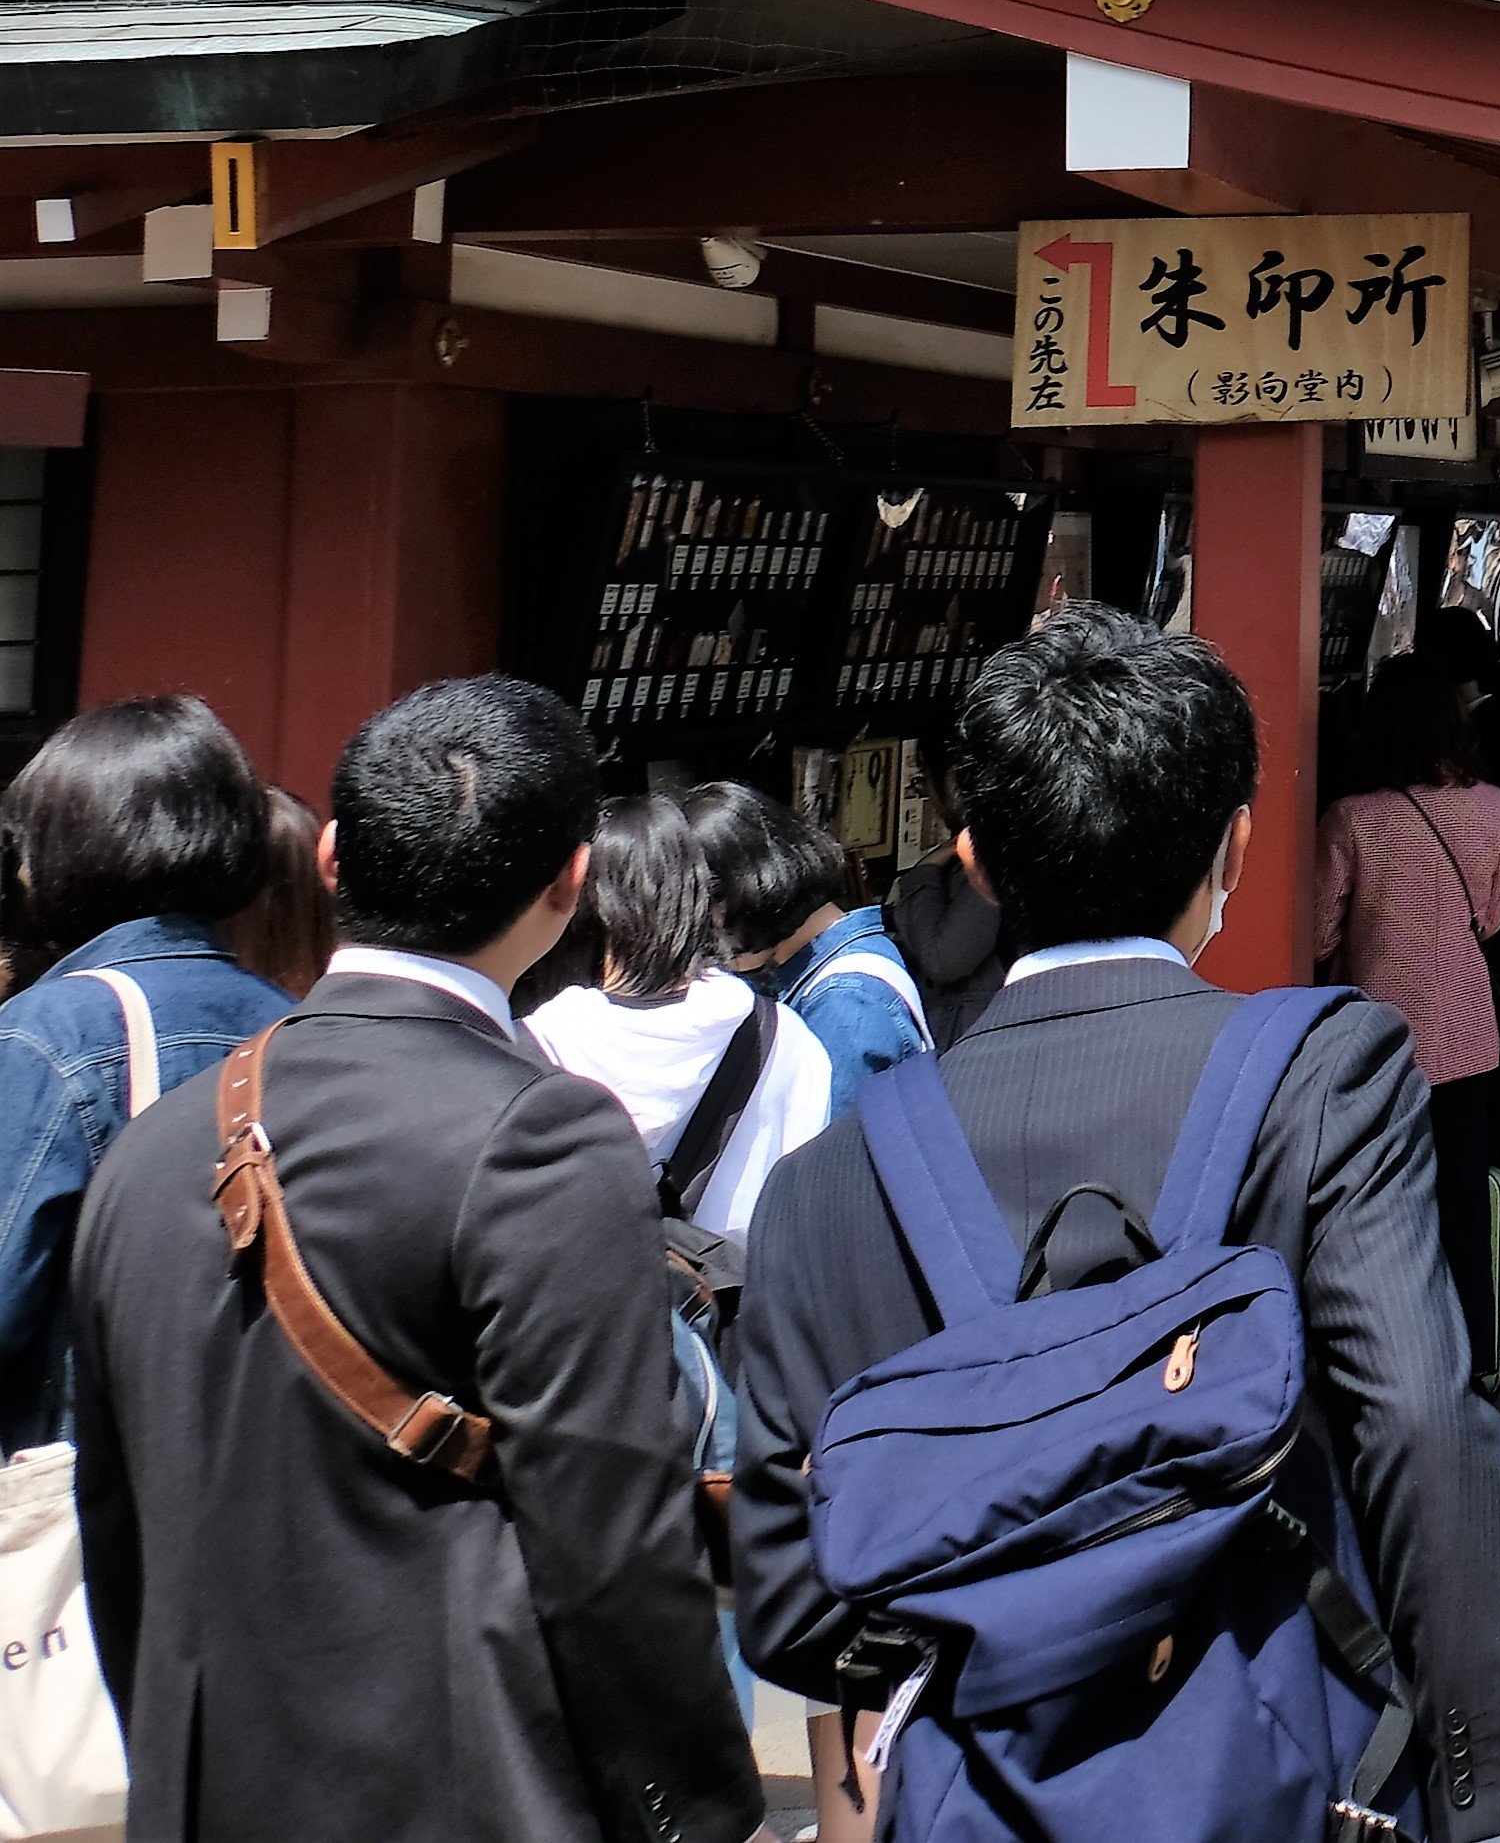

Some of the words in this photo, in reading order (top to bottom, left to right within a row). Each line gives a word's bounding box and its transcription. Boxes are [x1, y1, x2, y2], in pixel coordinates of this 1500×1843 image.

[1025, 276, 1068, 413] この先左
[1138, 245, 1446, 351] 朱印所
[1187, 368, 1395, 407] （影向堂内）
